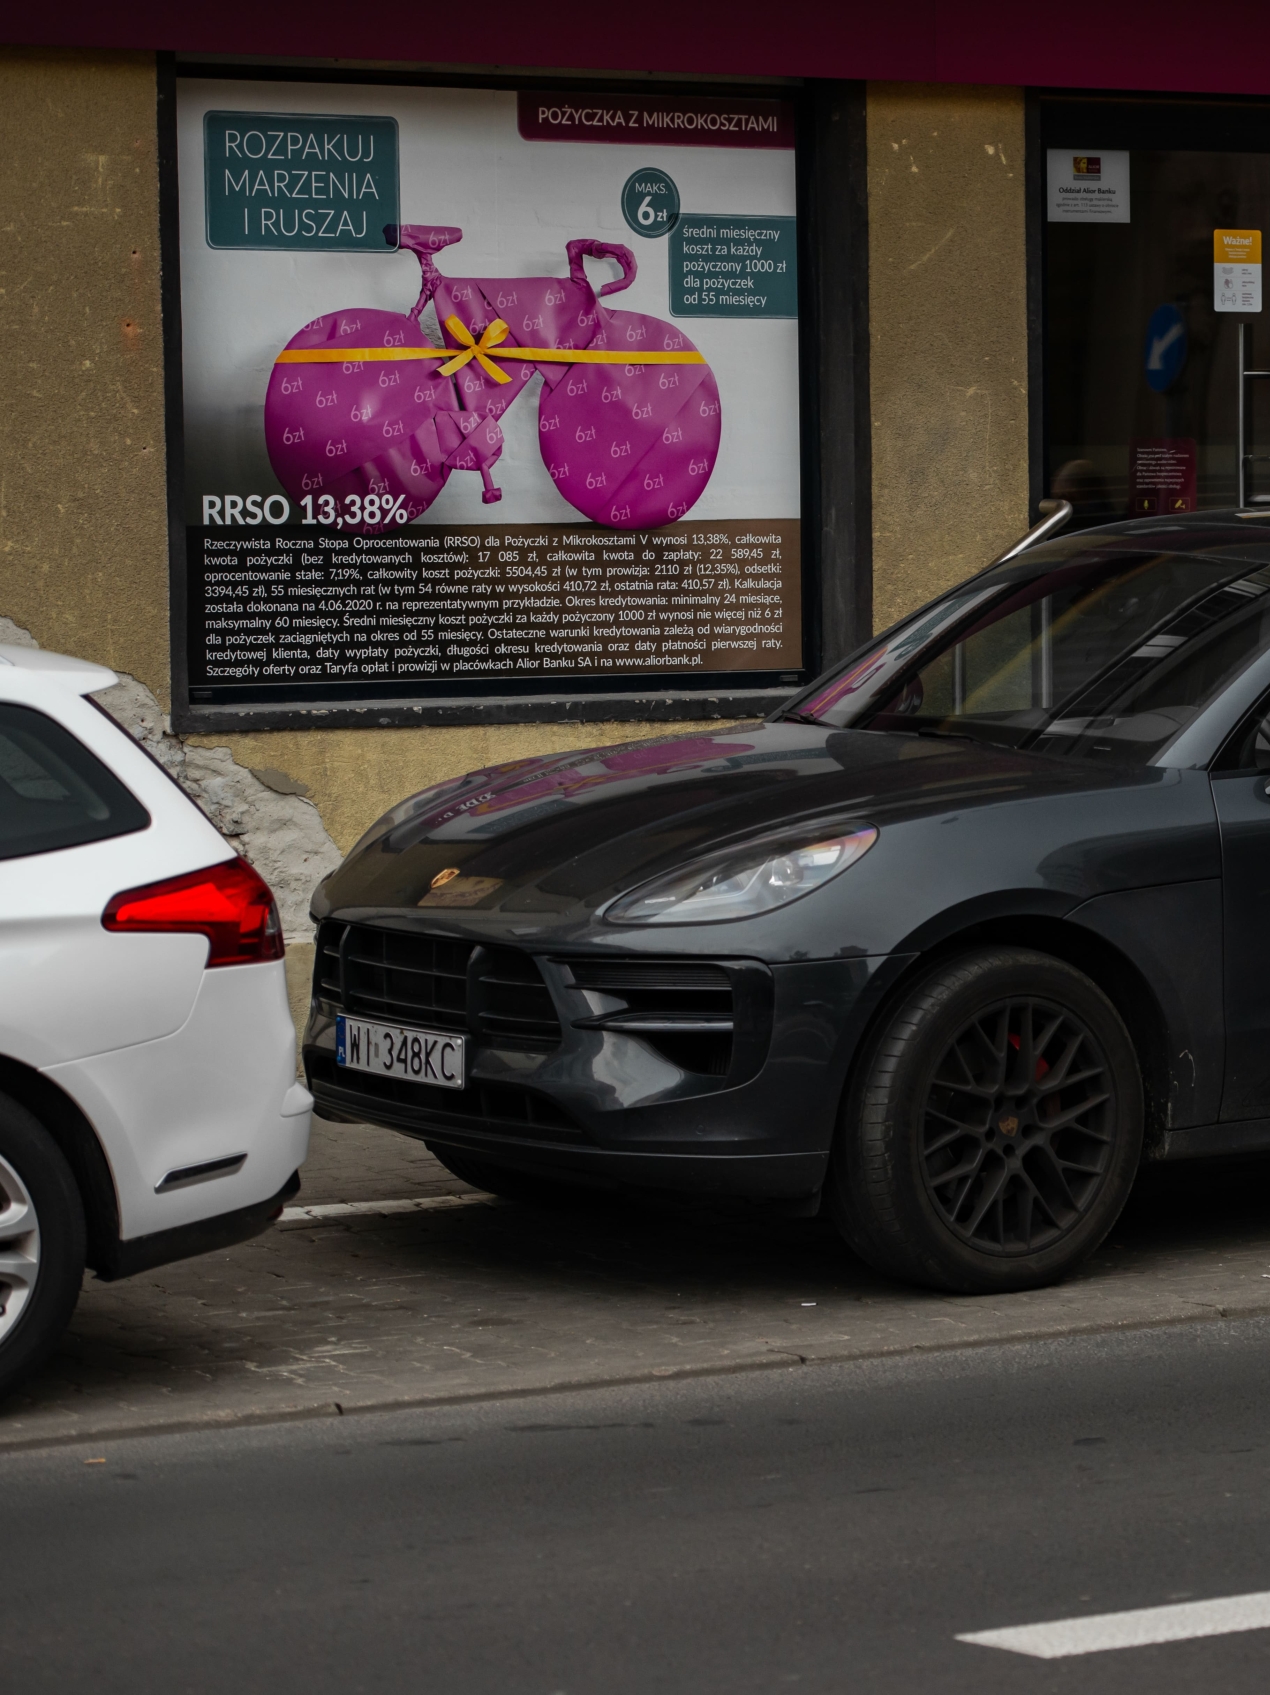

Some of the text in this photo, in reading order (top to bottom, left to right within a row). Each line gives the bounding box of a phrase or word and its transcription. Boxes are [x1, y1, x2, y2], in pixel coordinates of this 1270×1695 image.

[538, 105, 777, 132] POŻYCZKA Z MIKROKOSZTAMI
[225, 130, 374, 161] ROZPAKUJ
[225, 169, 379, 200] MARZENIA
[635, 182, 668, 194] MAKS.
[637, 196, 667, 225] 6 zł
[244, 208, 367, 237] I RUSZAJ
[682, 225, 780, 241] średni miesięczny
[1222, 236, 1253, 246] Ważne!
[683, 242, 763, 257] koszt za każdy
[683, 259, 787, 274] pożyczony 1000 zł
[683, 275, 754, 290] dla pożyczek
[545, 289, 565, 306] 6zł
[683, 292, 767, 307] od 55 miesięcy
[626, 325, 647, 342] 6zł
[281, 377, 303, 394] 6zł
[379, 370, 400, 387] 6zł
[659, 372, 679, 390] 6zł
[316, 390, 337, 408] 6zł
[351, 404, 372, 422] 6zł
[632, 403, 652, 420] 6zł
[283, 427, 305, 444] 6zł
[383, 420, 404, 438] 6zł
[575, 426, 596, 443] 6zł
[202, 494, 408, 530] RRSO 13,38%
[204, 533, 781, 551] Rzeczywista Roczna Stopa Oprocentowania (RRSO) dla Pożyczki z Mikrokosztami V wynosi 13,38%, całkowita
[204, 547, 781, 567] kwota pożyczki (bez kredytowanych kosztów): 17 085 zł, całkowita kwota do zapłaty: 22 589,45 zł,
[204, 562, 781, 583] oprocentowanie stałe: 7,19%, całkowity koszt pożyczki: 5504,45 zł (w tym prowizja: 2110 zł (12,35%), odsetki:
[204, 592, 782, 612] została dokonana na 4.06.2020 r. na reprezentatywnym przykładzie. Okres kredytowania: minimalny 24 miesiące,
[205, 622, 782, 646] dla pożyczek zaciągniętych na okres od 55 miesięcy. Ostateczne warunki kredytowania zależą od wiarygodności
[206, 637, 782, 662] kredytowej klienta, daty wypłaty pożyczki, długości okresu kredytowania oraz daty płatności pierwszej raty.
[350, 1024, 456, 1081] WI 348KC
